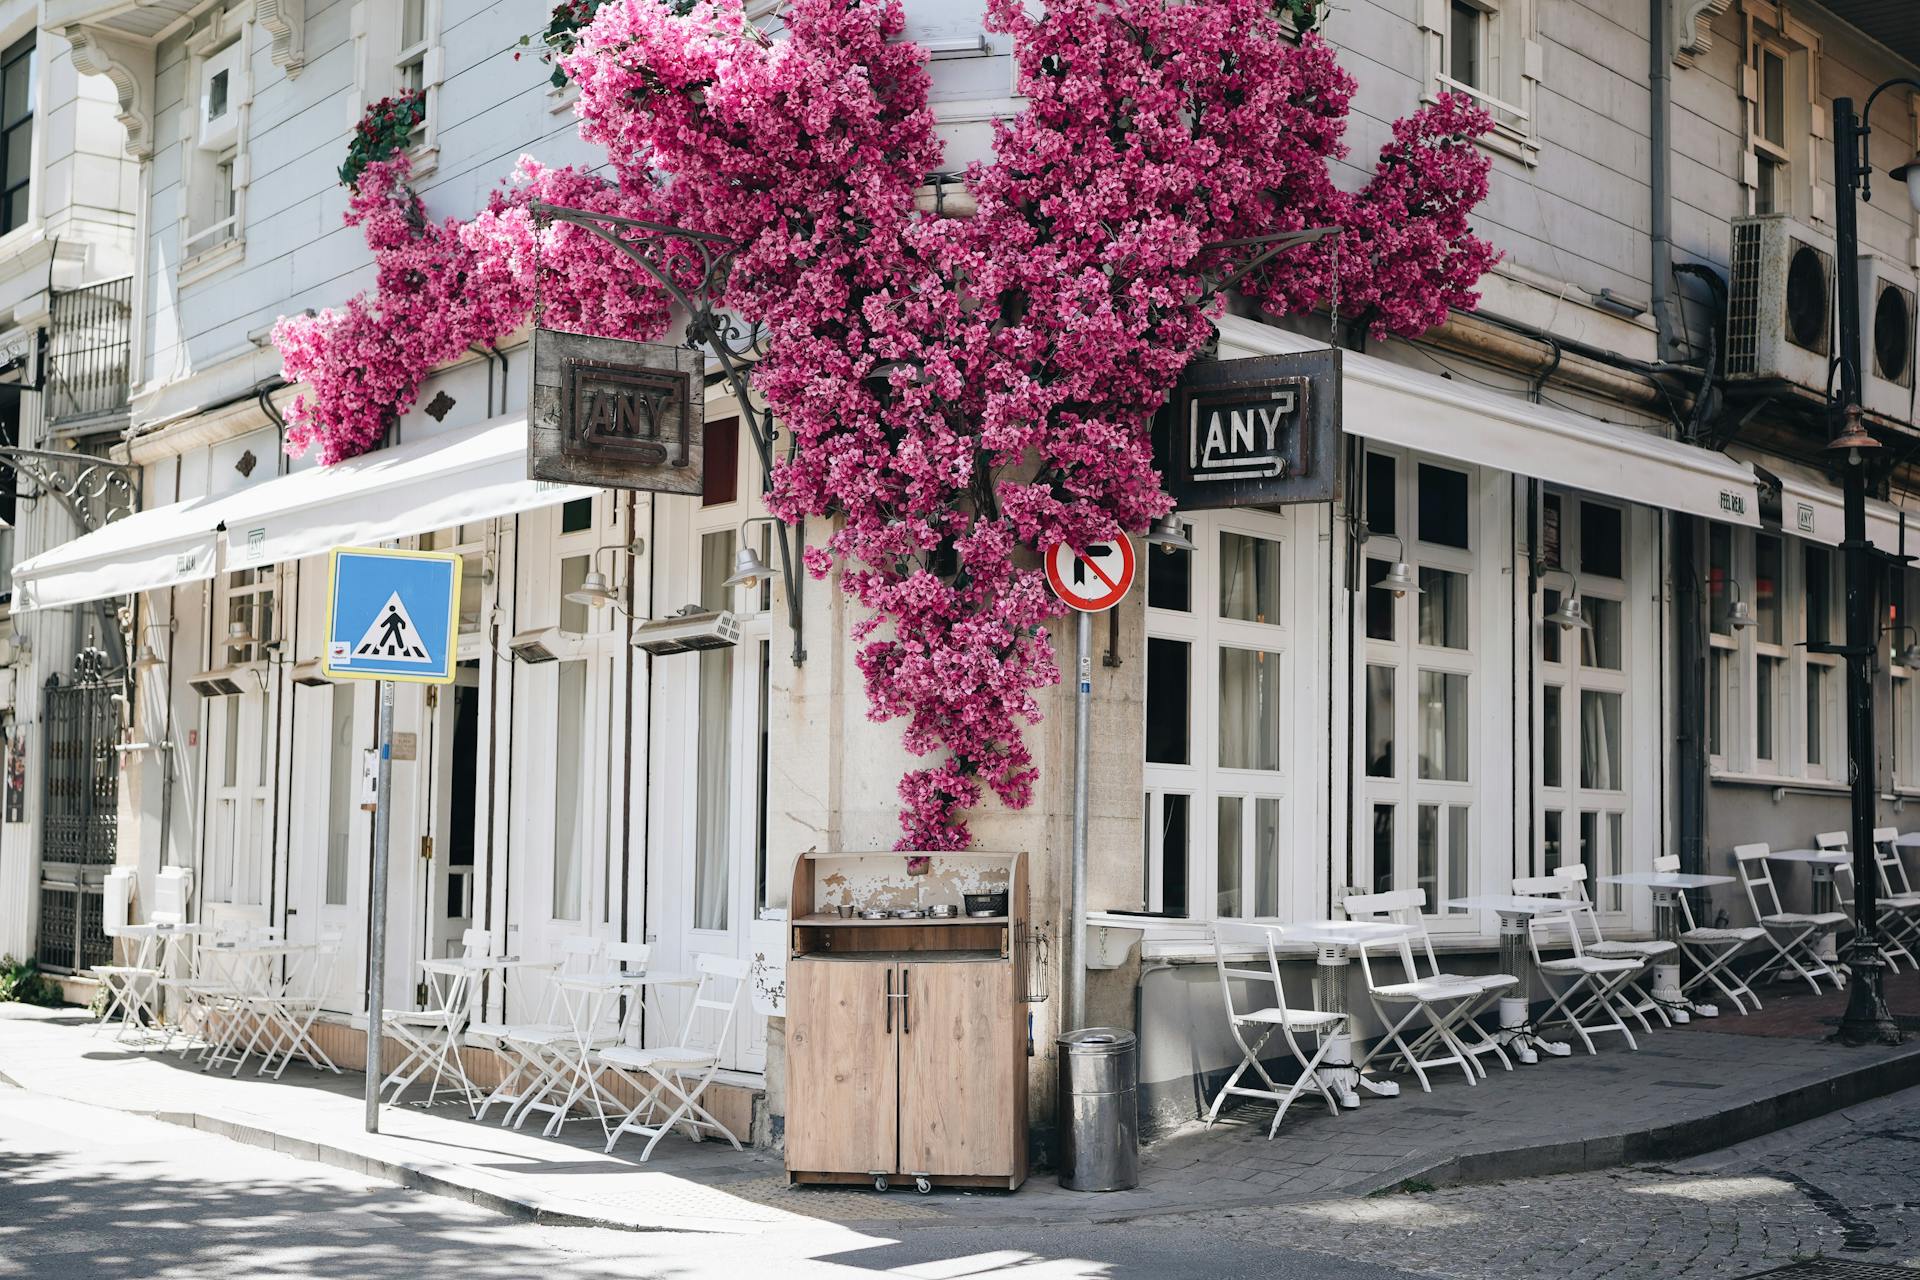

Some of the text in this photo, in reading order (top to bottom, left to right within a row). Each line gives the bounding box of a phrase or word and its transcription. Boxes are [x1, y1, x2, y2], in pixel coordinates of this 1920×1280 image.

[589, 389, 668, 436] ANY
[1203, 408, 1282, 454] ANY
[1720, 492, 1744, 514] FEEL REAL
